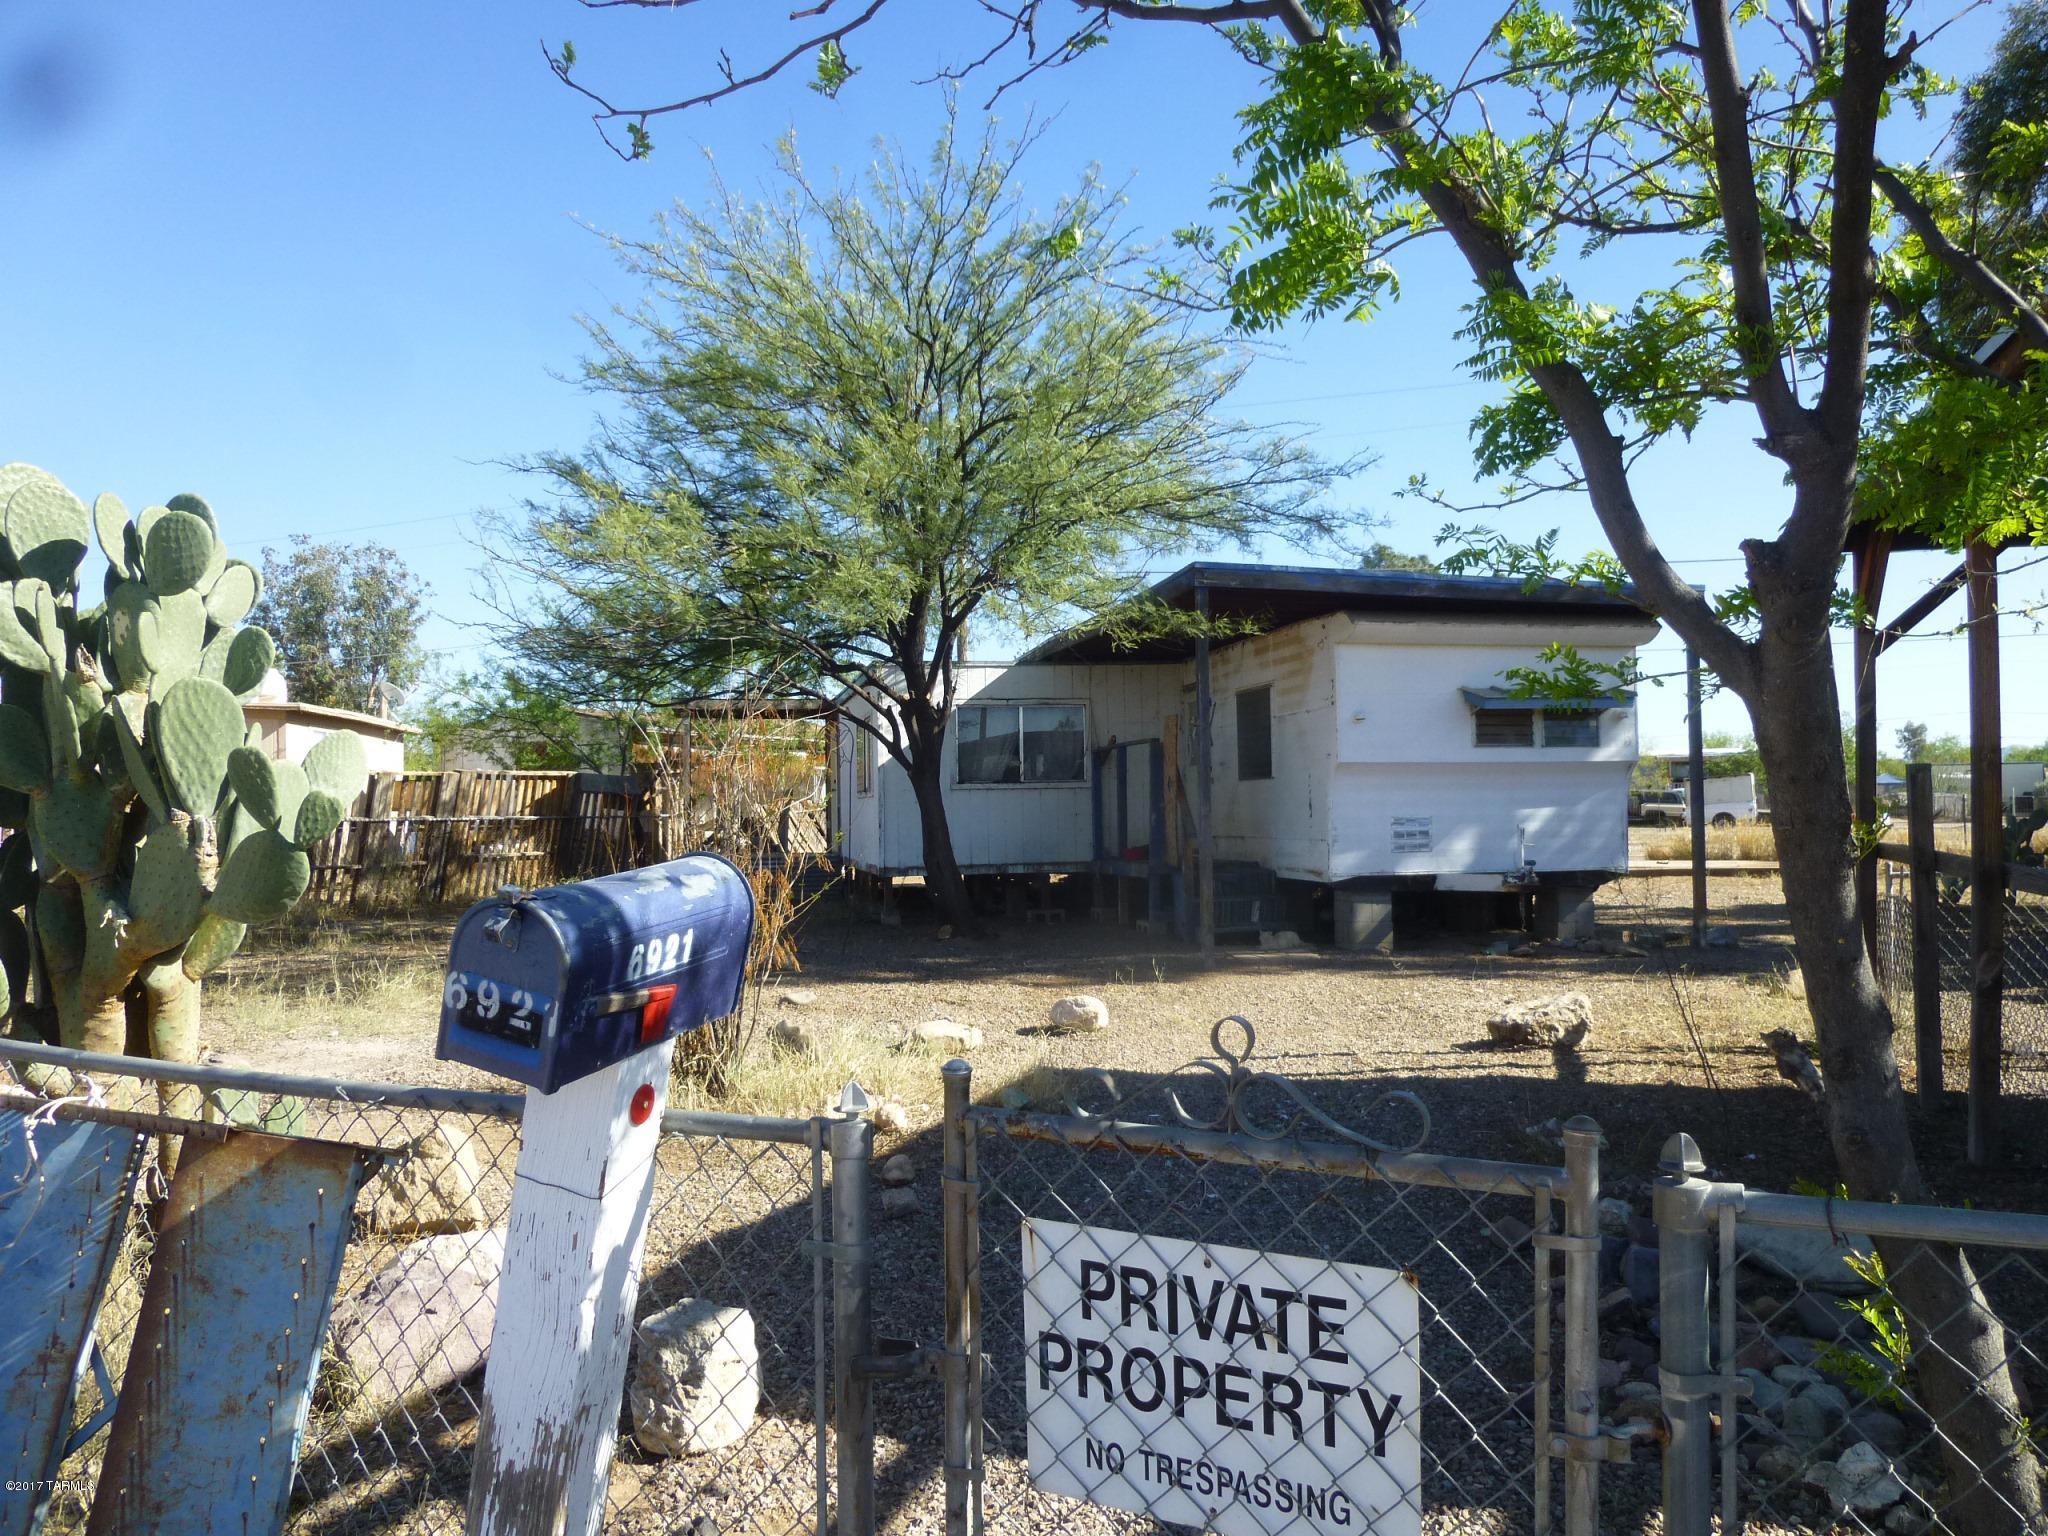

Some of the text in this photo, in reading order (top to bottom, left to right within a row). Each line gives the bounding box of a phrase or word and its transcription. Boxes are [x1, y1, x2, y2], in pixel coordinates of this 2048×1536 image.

[628, 928, 694, 981] 6921
[1080, 1259, 1349, 1364] PRIVATE
[1039, 1331, 1402, 1457] PROPERTY
[1086, 1438, 1352, 1526] NO TRESPASSING
